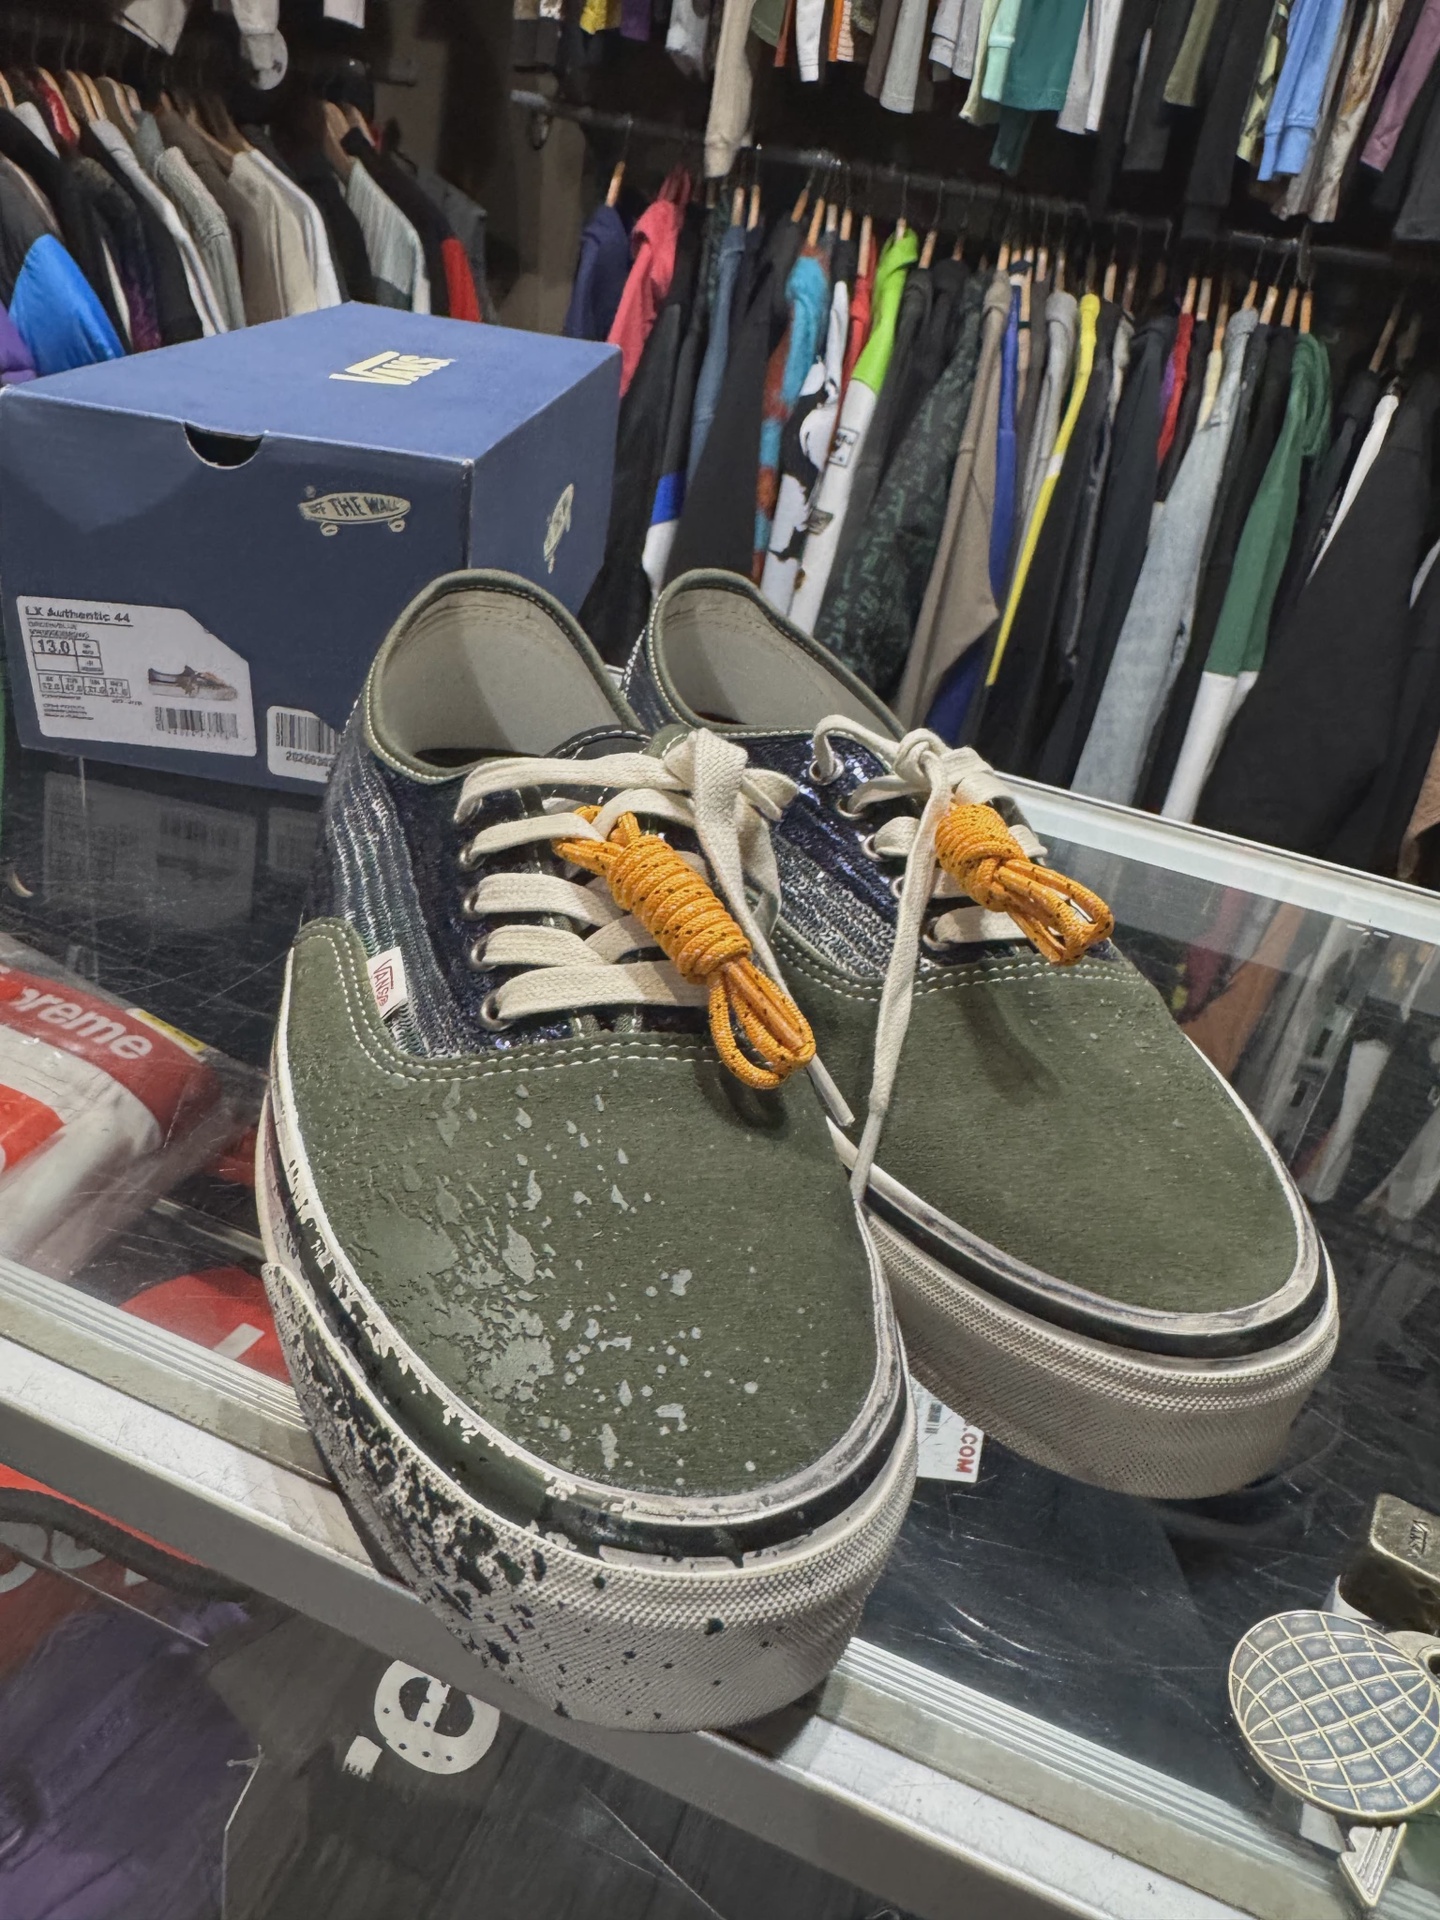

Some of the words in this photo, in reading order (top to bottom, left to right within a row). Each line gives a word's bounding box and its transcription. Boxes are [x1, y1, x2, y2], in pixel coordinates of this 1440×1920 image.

[327, 496, 368, 517] THE
[25, 605, 44, 616] LX
[47, 607, 110, 622] Authentic
[114, 612, 131, 623] 44
[373, 958, 394, 1003] VANS
